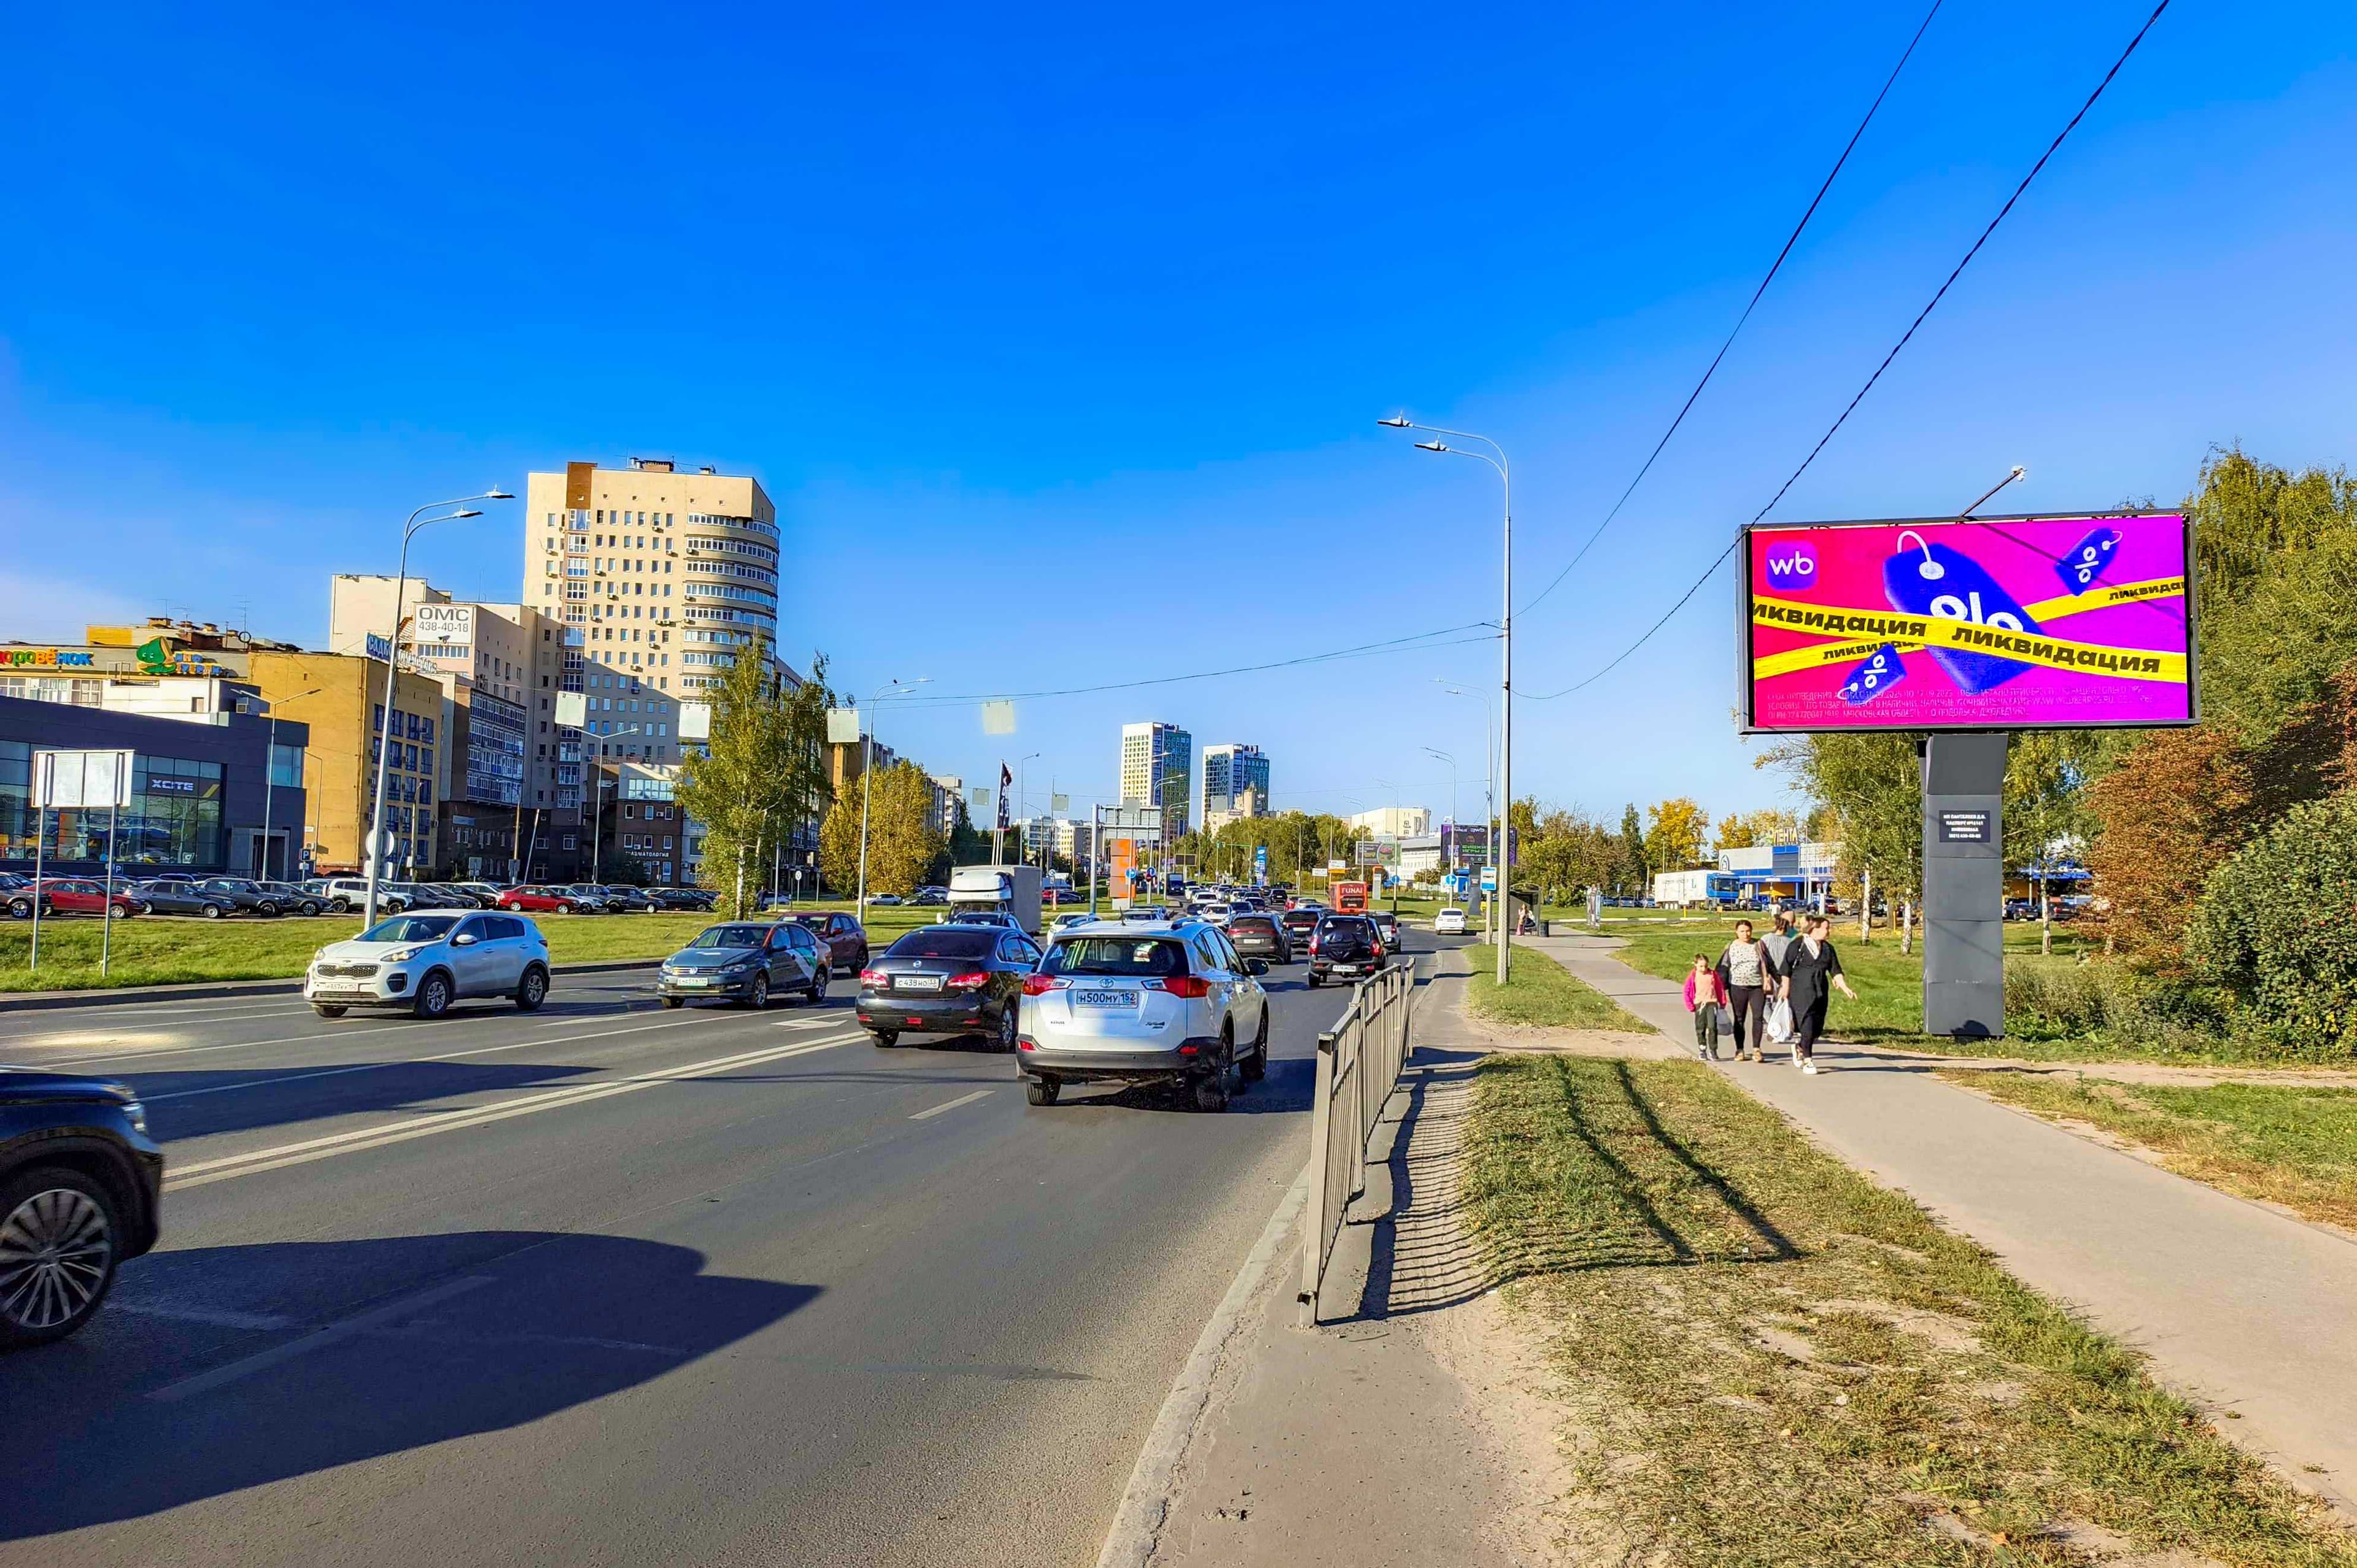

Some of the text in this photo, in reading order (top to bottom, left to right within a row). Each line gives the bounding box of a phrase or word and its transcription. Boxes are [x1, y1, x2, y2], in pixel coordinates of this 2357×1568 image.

[1769, 550, 1814, 575] wb
[419, 621, 468, 633] 438-40-18
[1951, 627, 2161, 673] ликвидация
